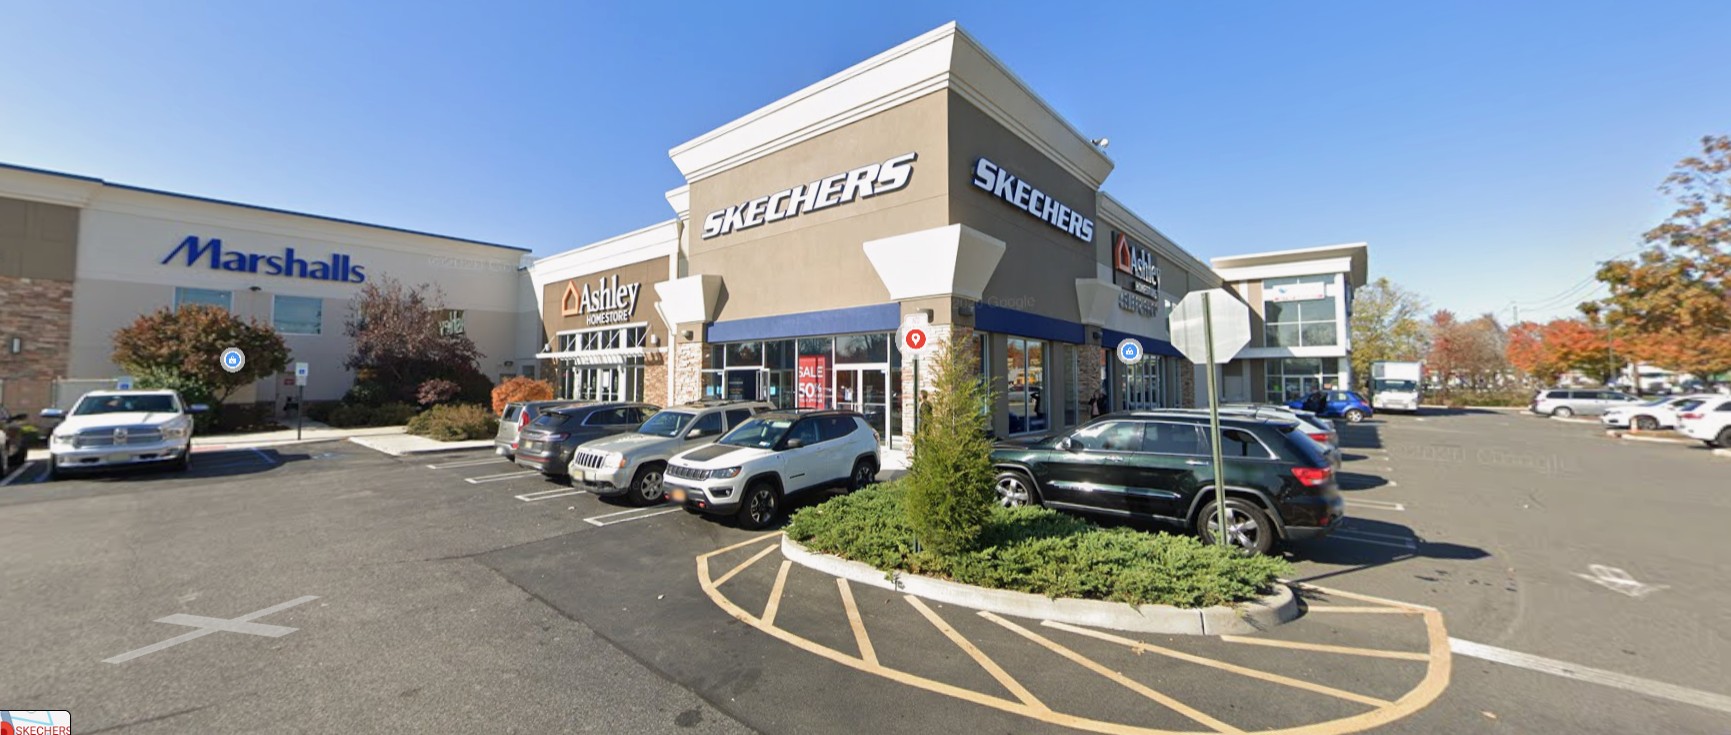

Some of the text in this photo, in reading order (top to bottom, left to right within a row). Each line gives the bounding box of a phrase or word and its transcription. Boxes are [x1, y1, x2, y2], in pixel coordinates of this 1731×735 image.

[701, 152, 918, 240] SKECHERS
[973, 157, 1094, 243] SKECHERS
[161, 235, 365, 283] Marshalls
[1130, 245, 1160, 291] Ashley
[579, 274, 640, 317] Ashley
[586, 310, 629, 325] HOMESTORE
[799, 365, 823, 378] SALE
